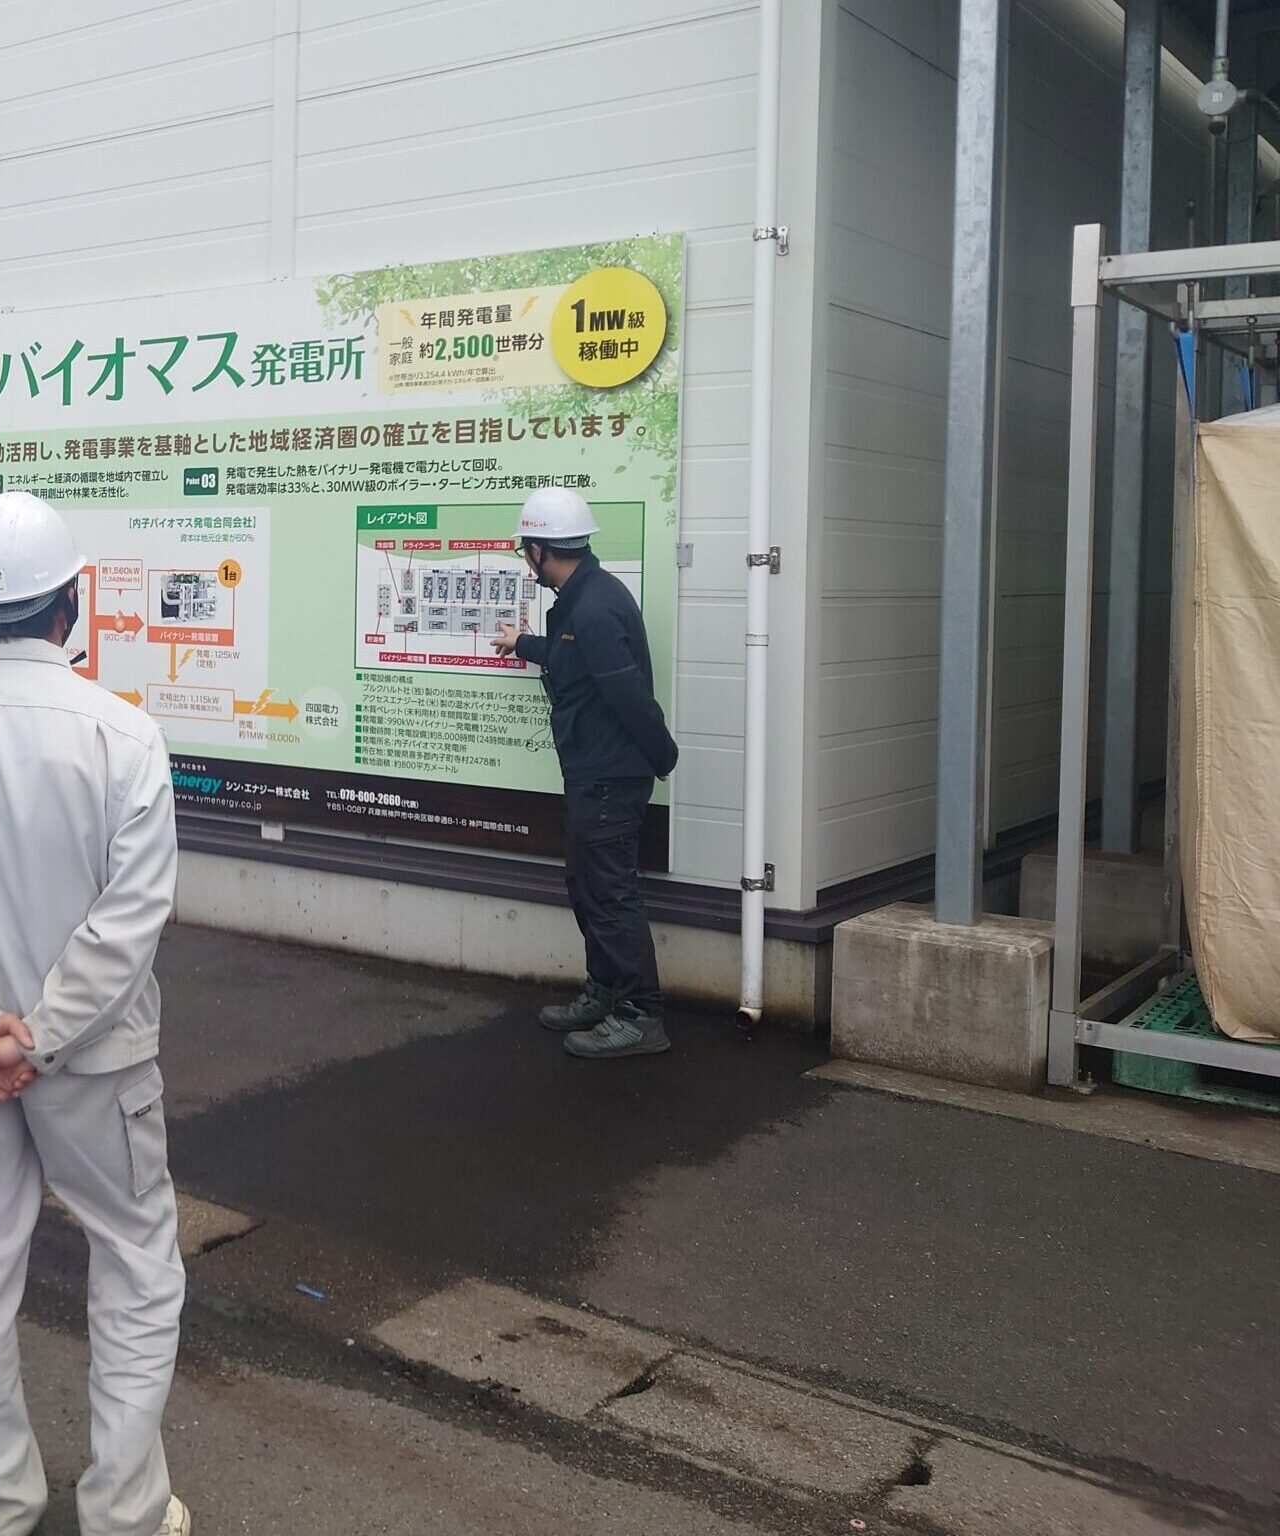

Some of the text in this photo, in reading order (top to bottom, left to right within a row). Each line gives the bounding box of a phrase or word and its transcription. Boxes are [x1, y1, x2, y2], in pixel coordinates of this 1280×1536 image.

[420, 304, 513, 330] 年間発電量
[389, 337, 414, 351] 一般
[579, 338, 639, 362] 稼働中
[389, 352, 414, 366] 家庭
[226, 458, 503, 479] 発電で発生した熱をバイナリー発電機で電力として回収。
[7, 469, 169, 485] エネルギーと経済の循環を地域内で確立し
[185, 473, 216, 488] Point 03
[7, 486, 130, 500] の雇用創出や林業を活性化。
[367, 512, 427, 525] レイアウト図
[222, 565, 236, 582] 1台
[305, 703, 339, 714] 四国電力
[305, 715, 339, 727] 株式会社
[226, 780, 310, 801] シン・エナジー株式会社
[175, 793, 262, 811] www.symenergy.co.jp
